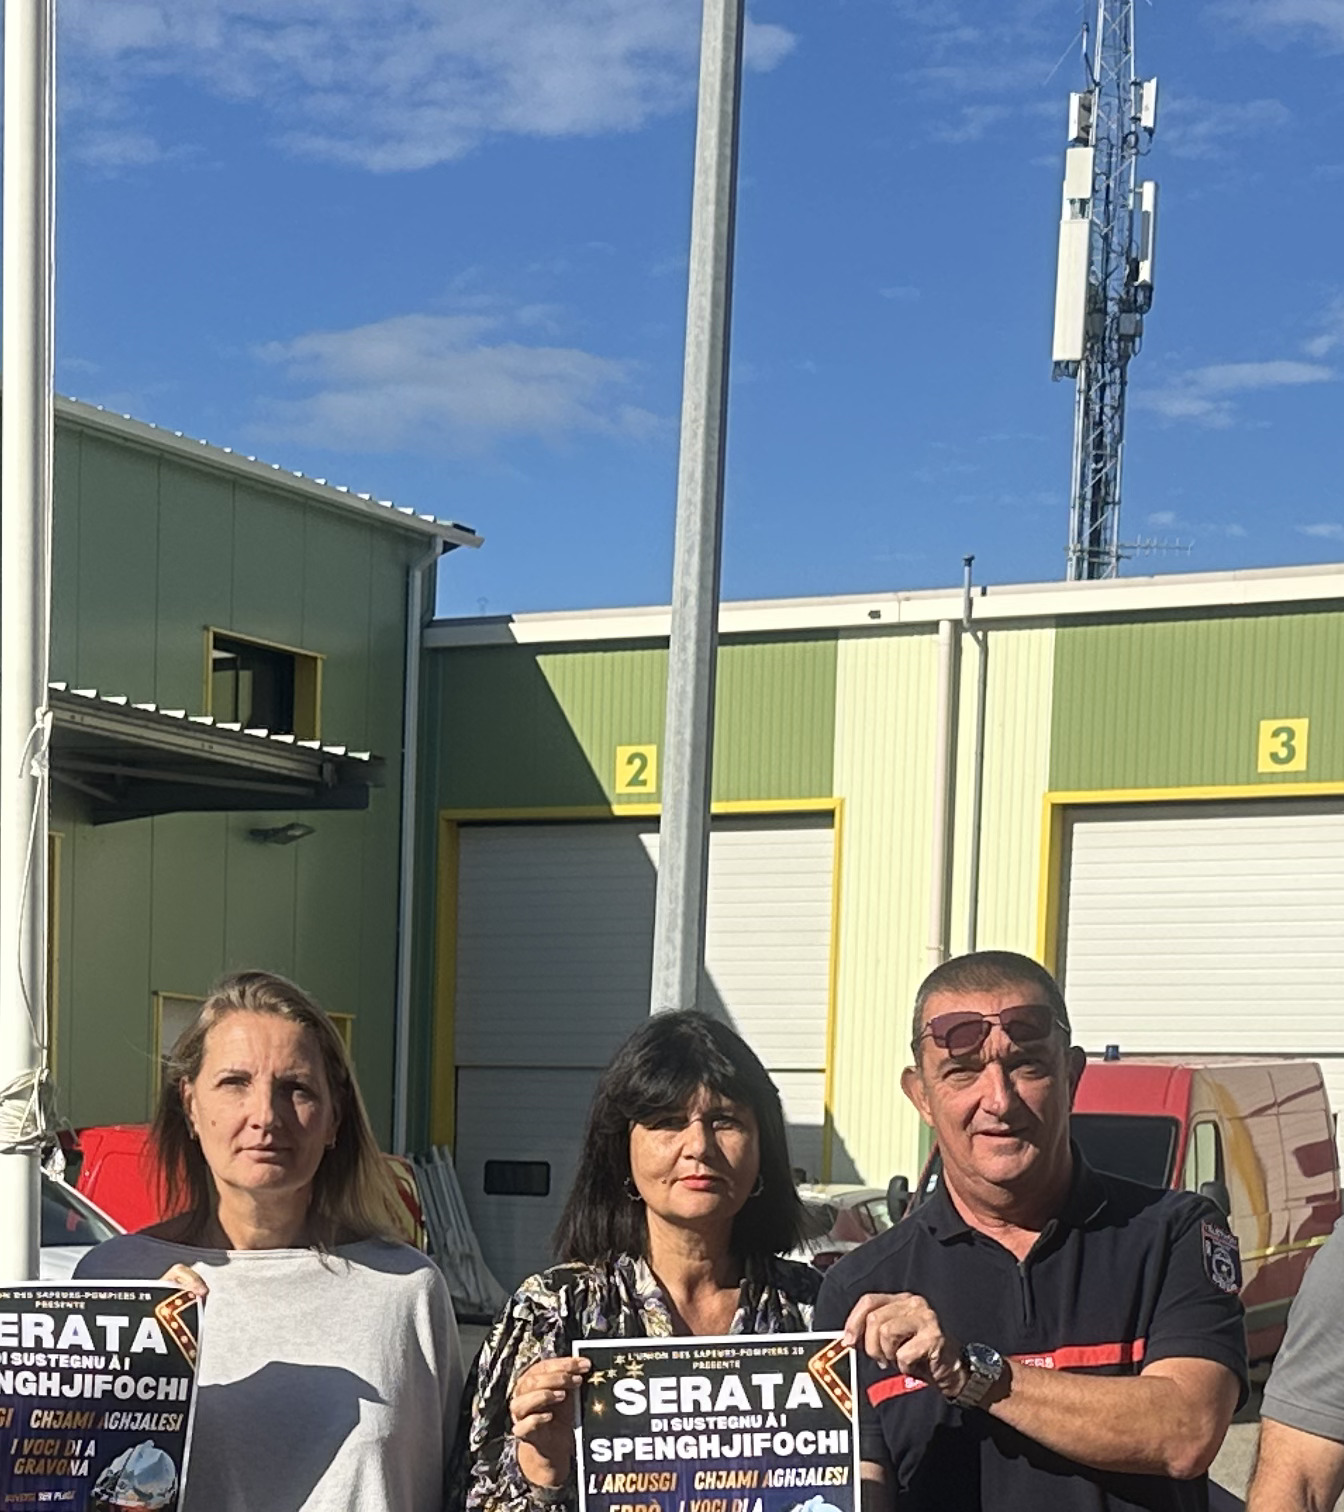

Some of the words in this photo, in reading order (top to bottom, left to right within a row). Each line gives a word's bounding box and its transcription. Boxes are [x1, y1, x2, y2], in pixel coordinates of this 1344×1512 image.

[1269, 726, 1296, 765] 3
[625, 752, 648, 787] 2
[10, 1354, 106, 1370] SUSTEGNU
[124, 1357, 130, 1371] I
[612, 1372, 824, 1416] SERATA
[30, 1409, 94, 1429] CHJAMI
[99, 1411, 184, 1431] AGHJALESI
[651, 1418, 668, 1432] DI
[671, 1415, 762, 1431] SUSTEGNU
[781, 1414, 787, 1427] I
[10, 1439, 17, 1455] I
[23, 1439, 59, 1456] VOCI
[63, 1440, 81, 1456] DI
[84, 1440, 96, 1456] A
[589, 1429, 850, 1462] SPENGHJIFOCHI
[14, 1458, 89, 1476] GRAVONA
[694, 1470, 758, 1490] CHJAMI
[762, 1466, 849, 1488] AGHJALESI
[588, 1472, 677, 1494] L'ARCUSGI
